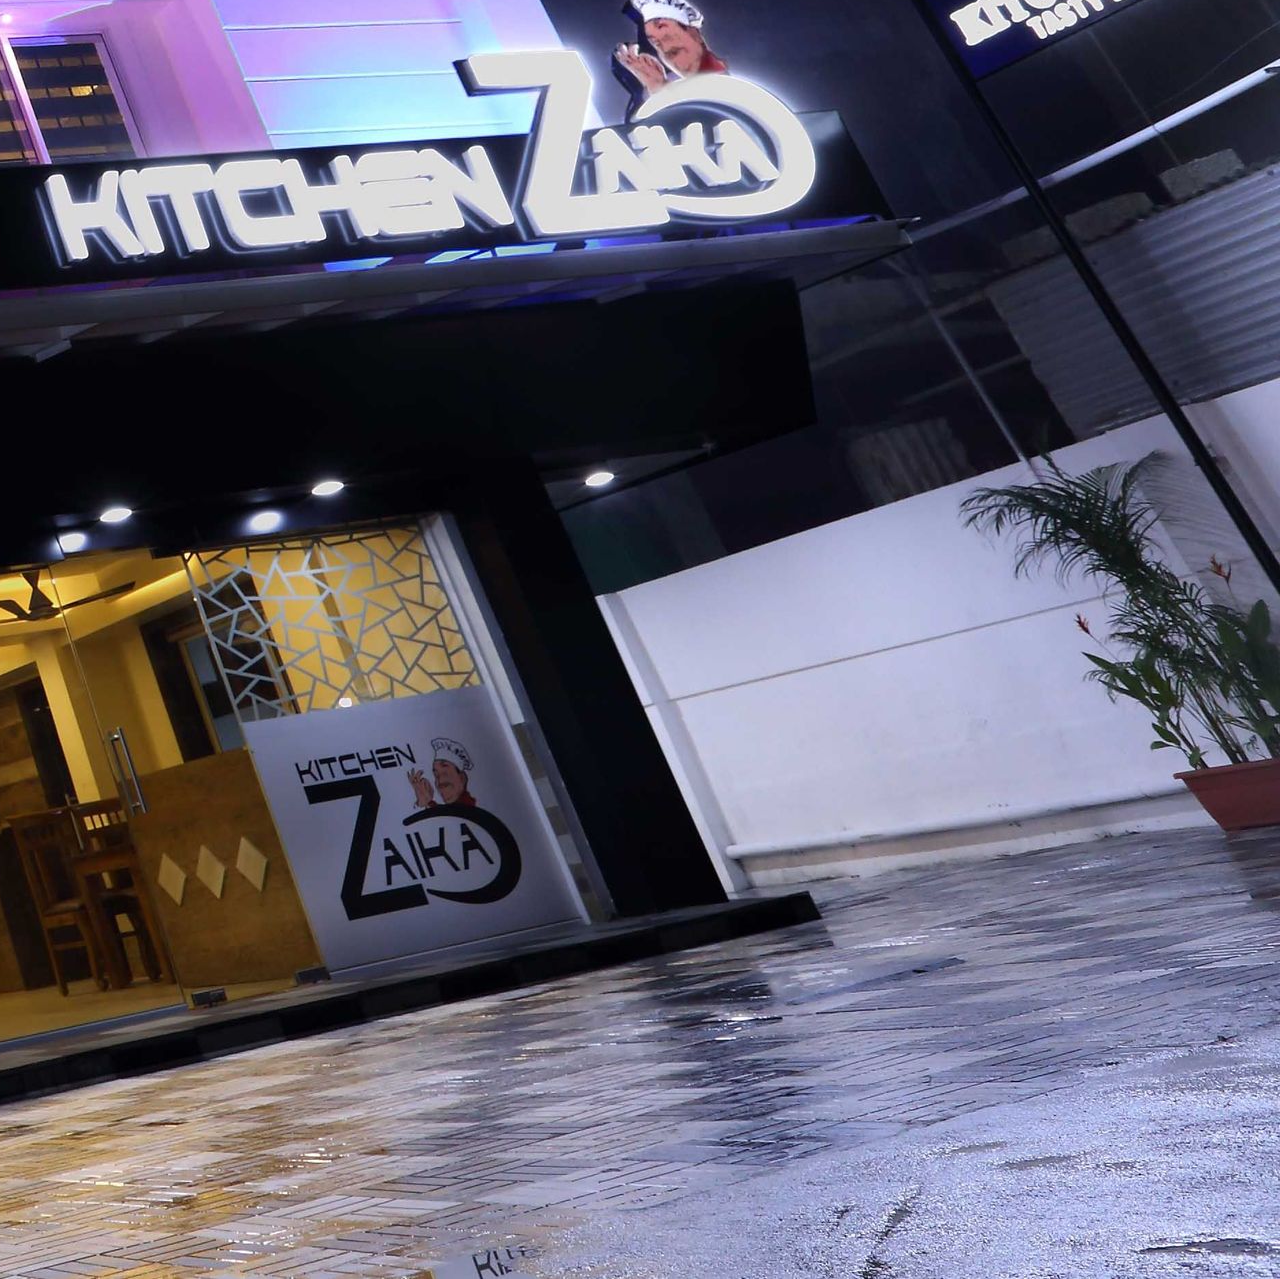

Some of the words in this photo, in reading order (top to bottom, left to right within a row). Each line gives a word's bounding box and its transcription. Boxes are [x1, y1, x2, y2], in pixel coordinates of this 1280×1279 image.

[44, 145, 516, 261] KITCHEN
[454, 48, 785, 235] ZAIKA
[294, 742, 417, 785] KITCHEN
[303, 774, 496, 922] ZAIKA
